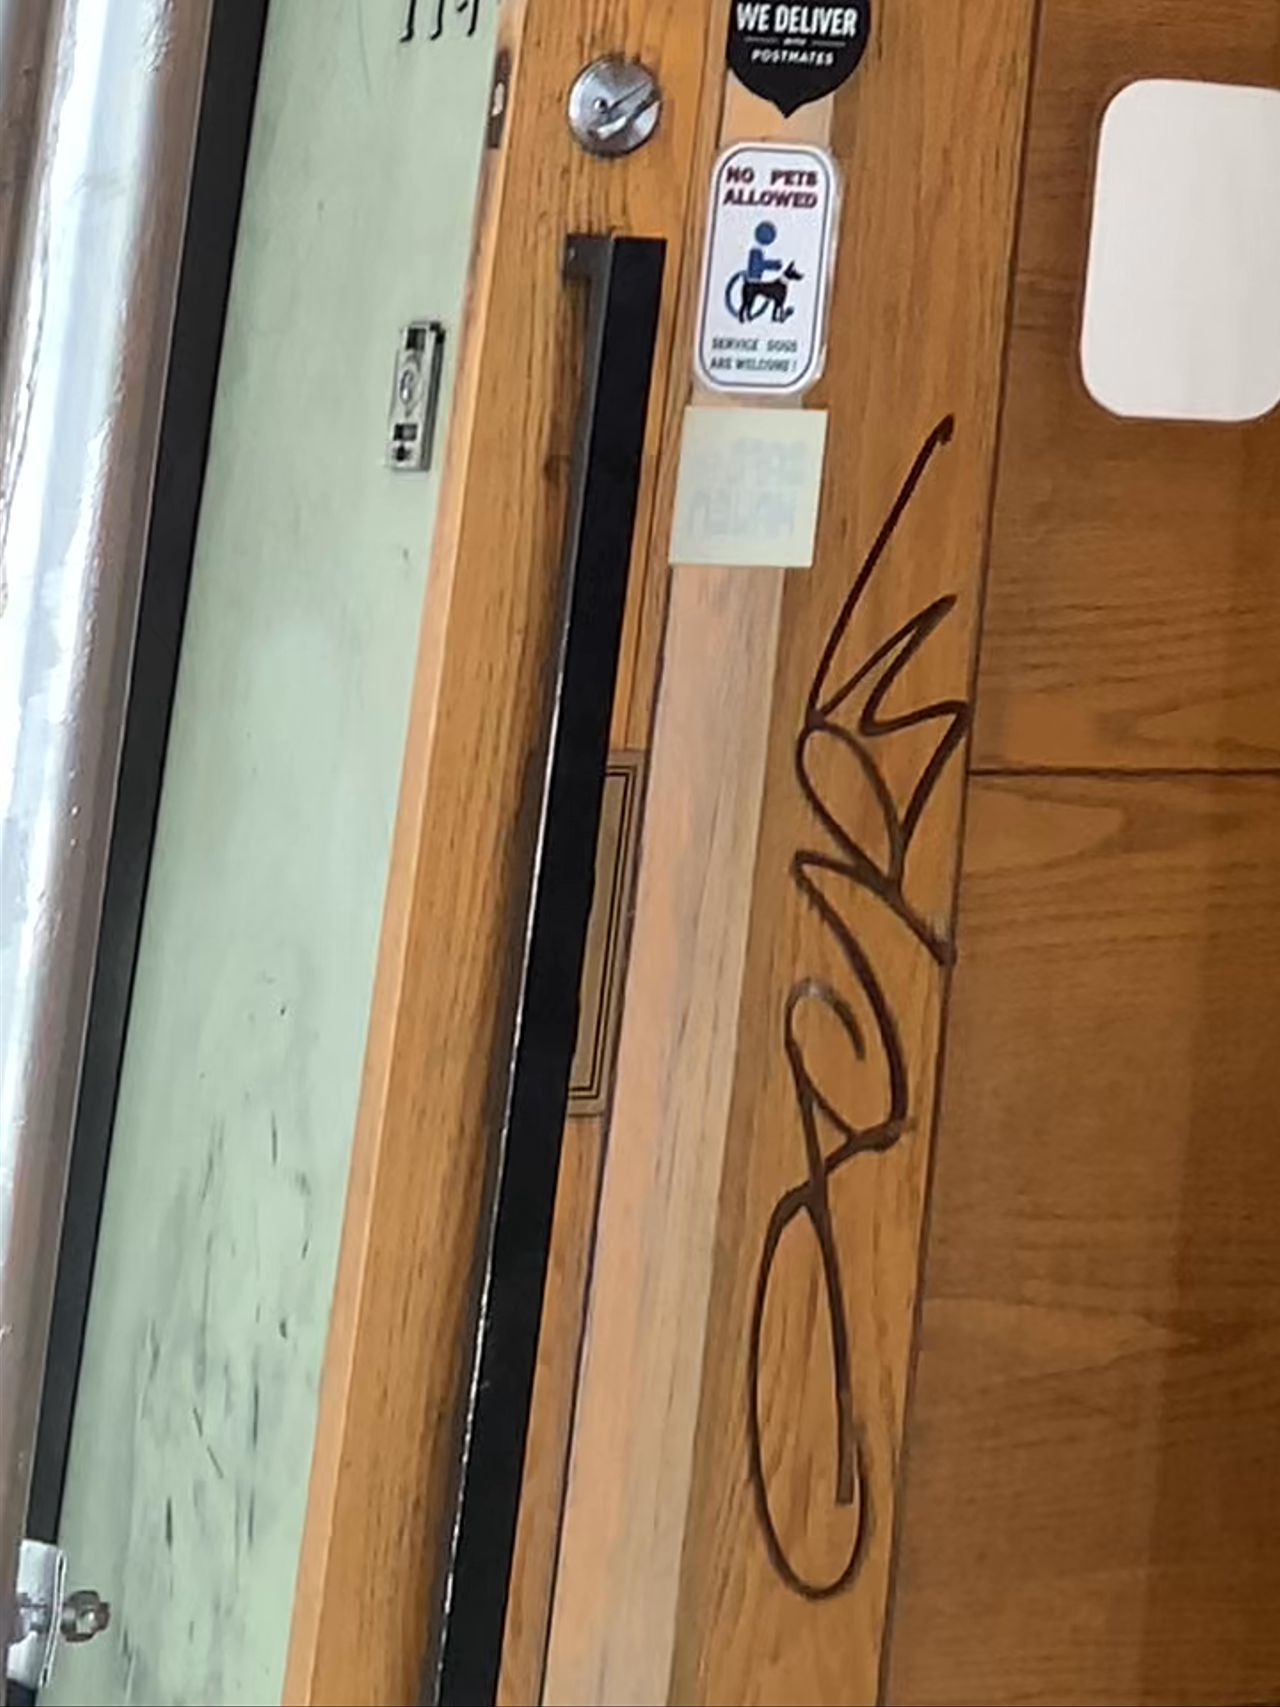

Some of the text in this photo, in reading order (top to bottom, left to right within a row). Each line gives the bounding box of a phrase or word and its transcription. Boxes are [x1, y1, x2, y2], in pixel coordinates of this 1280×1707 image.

[736, 2, 859, 38] WE DELIVER
[751, 48, 834, 66] POSTMATES
[726, 166, 818, 187] NO PETS
[723, 187, 818, 209] ALLOWED
[712, 336, 759, 352] SERVICE
[710, 357, 733, 370] ARE
